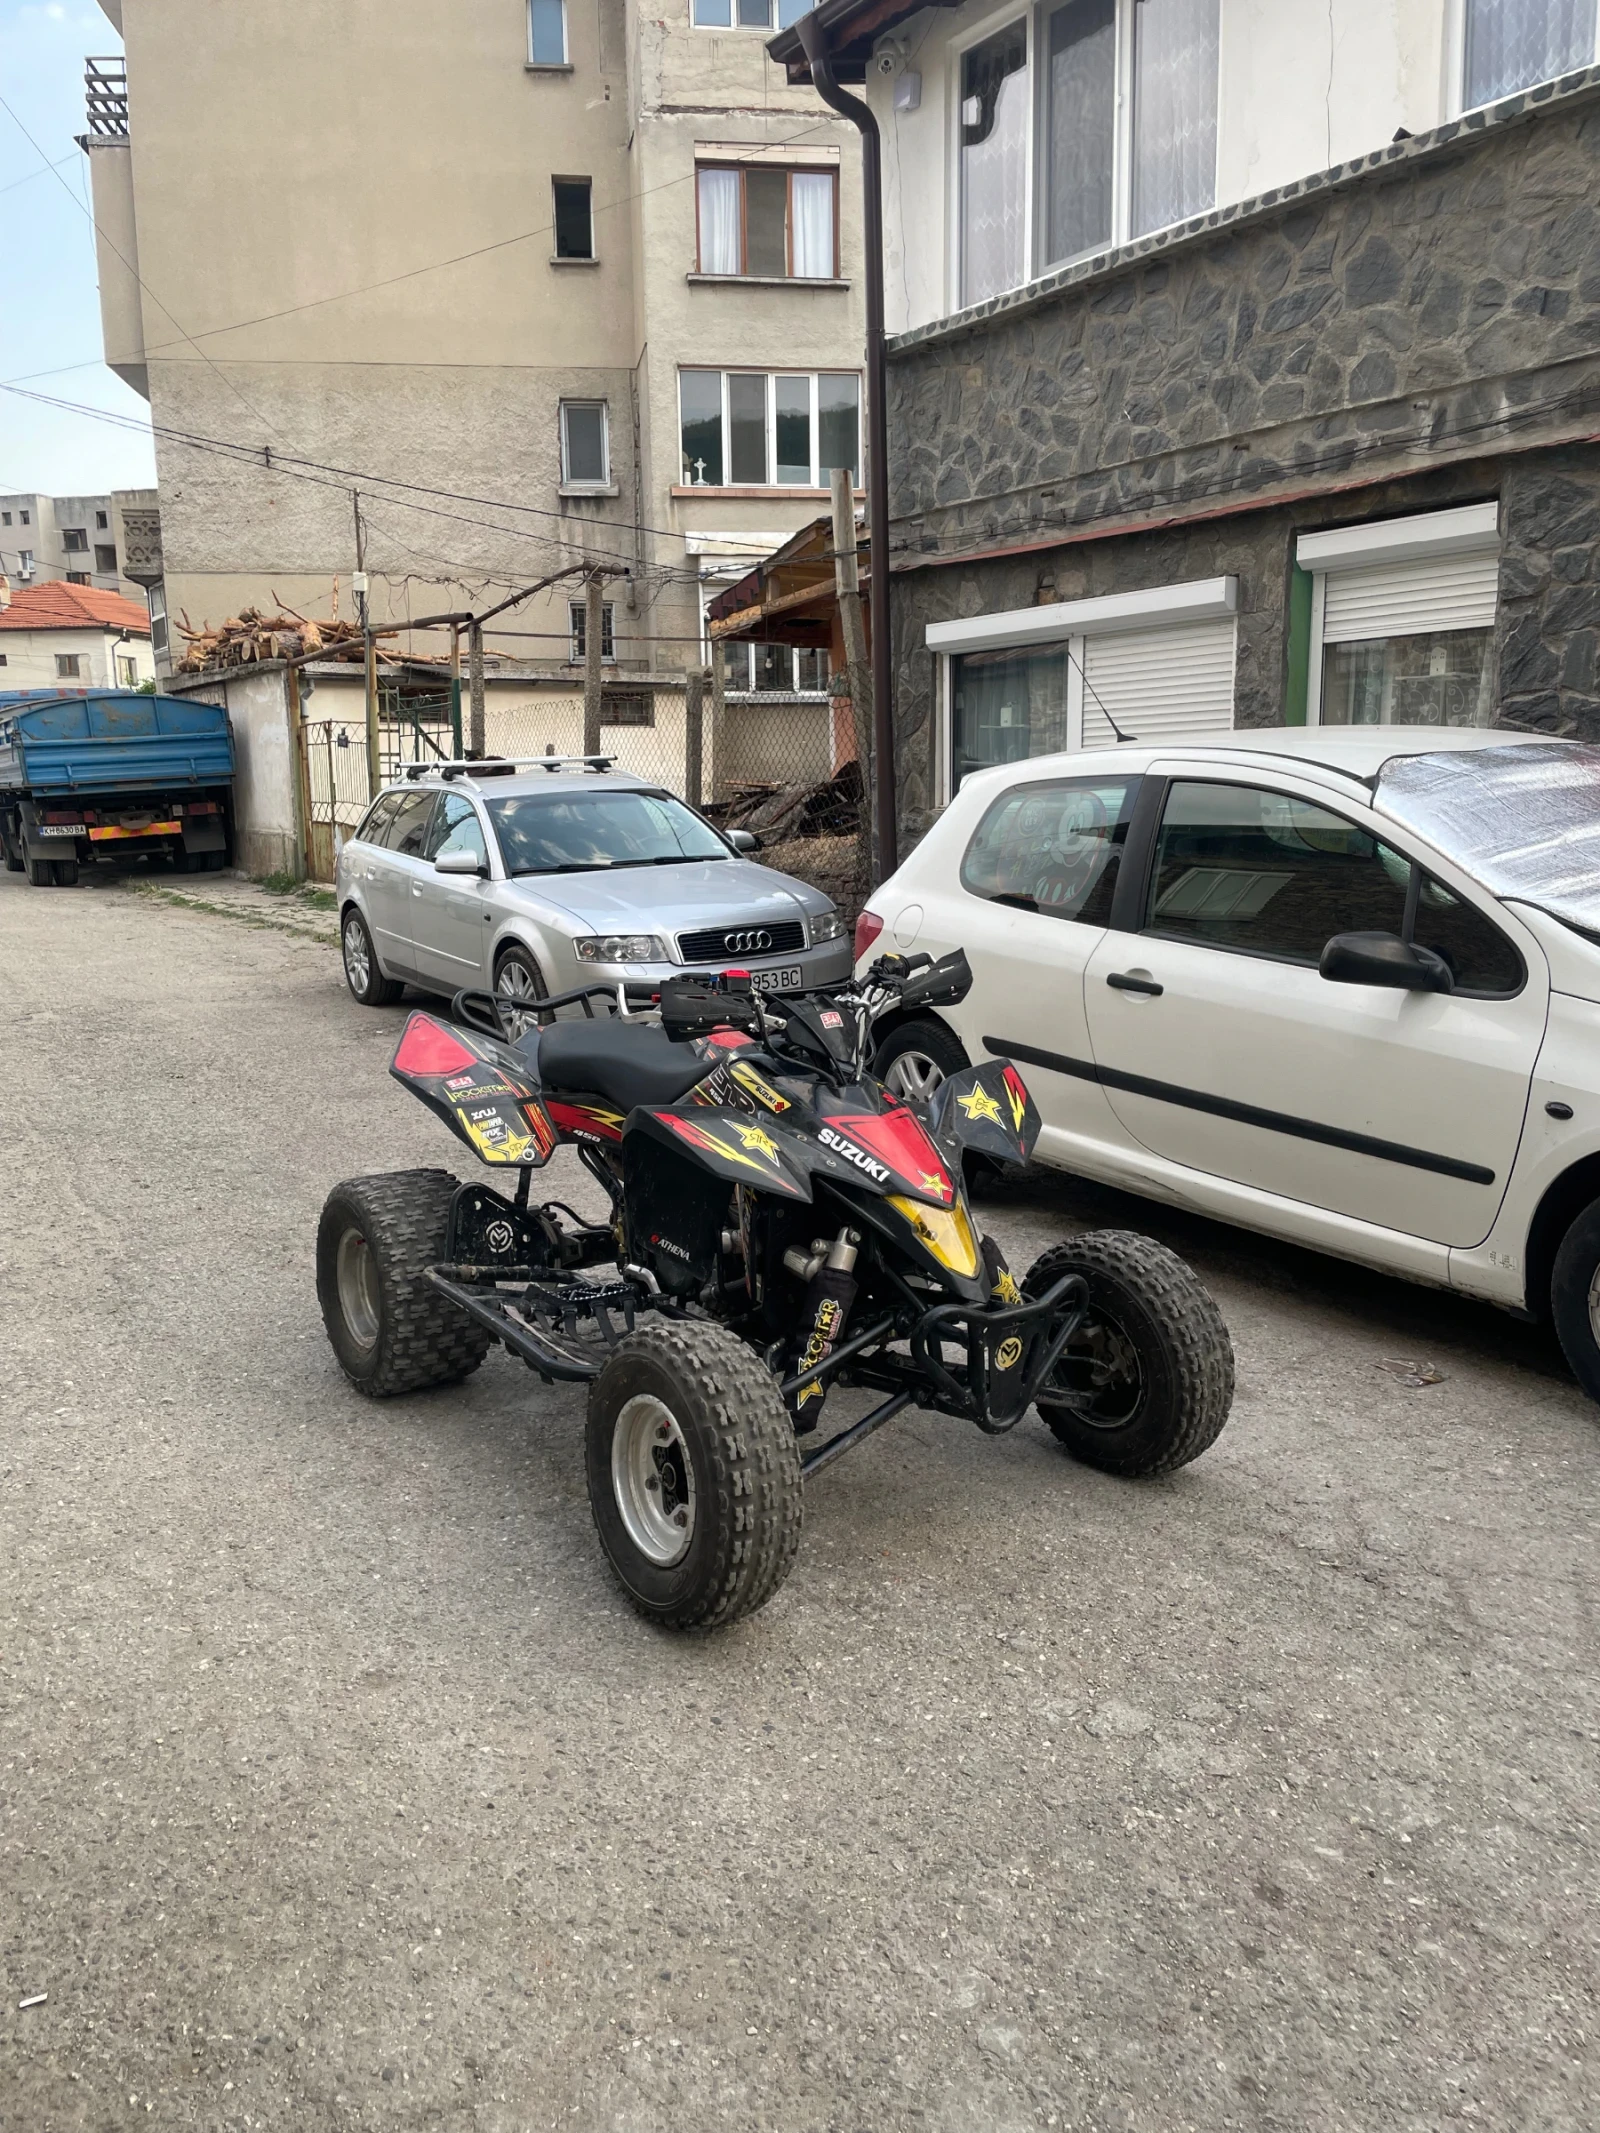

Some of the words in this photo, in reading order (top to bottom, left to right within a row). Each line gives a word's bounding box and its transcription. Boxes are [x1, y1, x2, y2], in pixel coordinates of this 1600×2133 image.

[781, 970, 799, 987] BC
[756, 1085, 776, 1105] SUZUKI
[573, 1130, 601, 1143] 450
[818, 1128, 890, 1182] SUZUKI
[658, 1239, 690, 1261] ATHENA
